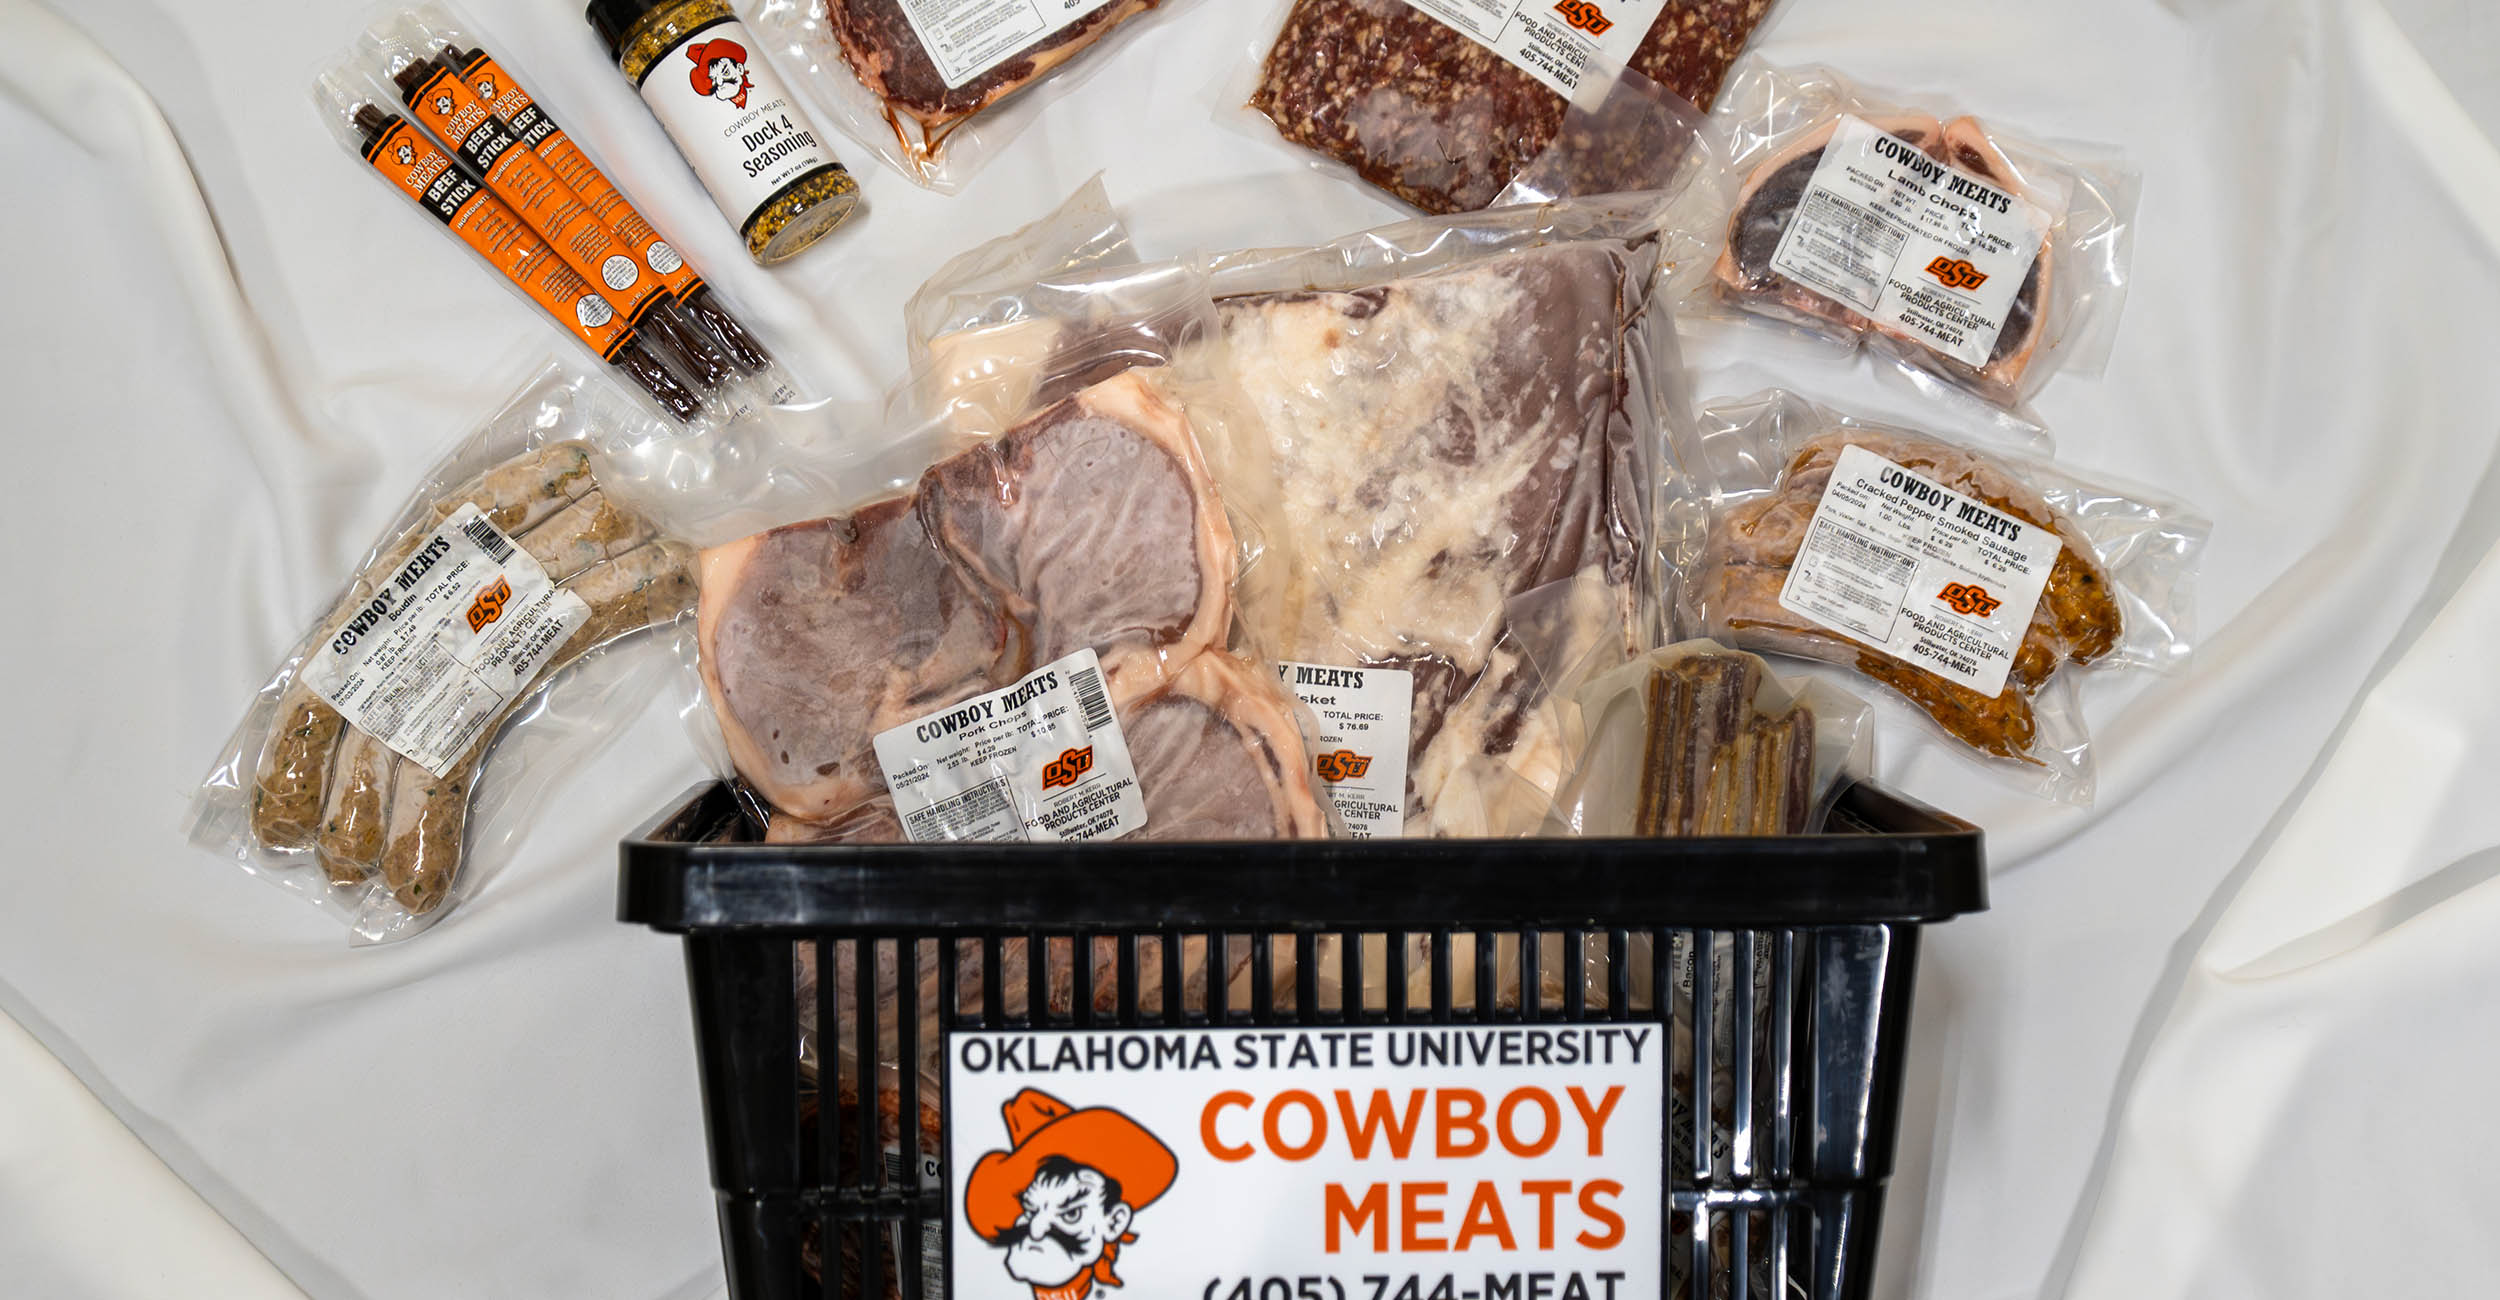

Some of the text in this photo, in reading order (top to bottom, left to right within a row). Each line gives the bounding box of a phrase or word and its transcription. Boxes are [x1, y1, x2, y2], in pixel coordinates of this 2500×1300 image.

[1514, 11, 1538, 28] FOOD
[1538, 26, 1556, 40] AND
[1524, 26, 1566, 56] PRODUCTS
[444, 100, 476, 136] COWBOY
[454, 106, 487, 144] MEATS
[500, 94, 529, 120] EATS
[724, 99, 786, 137] COWBOY MEATS
[467, 121, 496, 155] BEEF
[477, 132, 513, 168] STICK
[523, 118, 555, 146] TICK
[741, 114, 793, 152] Dock 4
[405, 150, 438, 186] COWBOY
[743, 130, 817, 178] Seasoning
[415, 156, 448, 193] MEATS
[427, 170, 457, 203] BEEF
[771, 176, 781, 185] Net
[1875, 137, 1946, 184] COWBOY
[1947, 175, 2011, 214] MEATS
[440, 179, 476, 215] STICK
[1888, 170, 1926, 196] Lamb
[1929, 194, 1977, 220] Chops
[1893, 189, 1906, 199] NET
[1814, 190, 1830, 201] SAFE
[1860, 213, 1905, 241] INSTRUCTIONS
[1869, 202, 1885, 213] KEEP
[1885, 210, 1932, 238] REFRIGERATED
[1944, 240, 1970, 256] FROZEN
[1888, 278, 1913, 294] FOOD
[1913, 291, 1933, 303] AND
[1924, 255, 1990, 292] OSU
[1900, 292, 1945, 317] PRODUCTS
[1946, 312, 1979, 330] CENTER
[1899, 314, 1964, 347] 405-744-MEAT
[1856, 478, 2027, 562] Cracked Pepper Smoked Sausage
[1880, 468, 2021, 542] COWBOY MEATS
[1836, 481, 1859, 496] Packed
[1881, 502, 1892, 511] Net
[1932, 527, 1947, 537] Price
[1978, 546, 2002, 563] TOTAL
[2004, 559, 2029, 574] PRICE:
[1836, 529, 1869, 548] HANDLING
[333, 588, 396, 655] COWBOY
[394, 535, 450, 592] MEATS
[388, 594, 417, 622] Boudin
[465, 574, 512, 635] OSU
[1936, 581, 2003, 619] OSU
[331, 560, 468, 701] Packed Net Price per TOTAL PRICE:
[488, 629, 527, 668] PRODUCTS
[525, 601, 551, 629] CENTER
[513, 619, 563, 676] 405-744-MEAT
[1901, 607, 1925, 623] FOOD
[1926, 620, 1946, 631] AND
[1947, 627, 2008, 660] AGRICULTURAL
[1913, 621, 1957, 645] PRODUCTS
[1959, 641, 1992, 660] CENTER
[381, 655, 395, 671] KEEP
[474, 653, 497, 675] FOOD
[1296, 666, 1363, 689] MEATS
[1913, 643, 1978, 677] 405-744-MEAT
[917, 700, 993, 743] COWBOY
[997, 671, 1058, 713] MEATS
[1323, 711, 1383, 721] TOTAL PRICE:
[959, 710, 1027, 741] Pork Chops
[1030, 730, 1036, 738] $
[1339, 722, 1344, 730] $
[892, 767, 917, 781] Packed
[936, 756, 948, 765] Net
[974, 739, 991, 748] Price
[992, 734, 1005, 744] per
[970, 746, 1017, 767] KEEP FROZEN
[1042, 745, 1093, 791] OSU
[1317, 749, 1372, 782] OSU
[909, 798, 961, 824] SAFE HANDLING
[1025, 777, 1133, 830] FOOD AND AGRICULTURAL
[1042, 805, 1088, 831] PRODUCTS
[1089, 792, 1120, 812] CENTER
[1087, 817, 1096, 825] OK
[1096, 809, 1114, 821] 74078
[1334, 800, 1398, 812] GRICULTURAL
[1344, 809, 1381, 820] CENTER
[1348, 823, 1368, 831] 74078
[960, 1028, 1652, 1073] OKLAHOMA STATE UNIVERSITY
[1200, 1085, 1626, 1162] COWBOY
[1325, 1179, 1626, 1254] MEATS
[1203, 1272, 1626, 1300] (405) 744-MEAT
